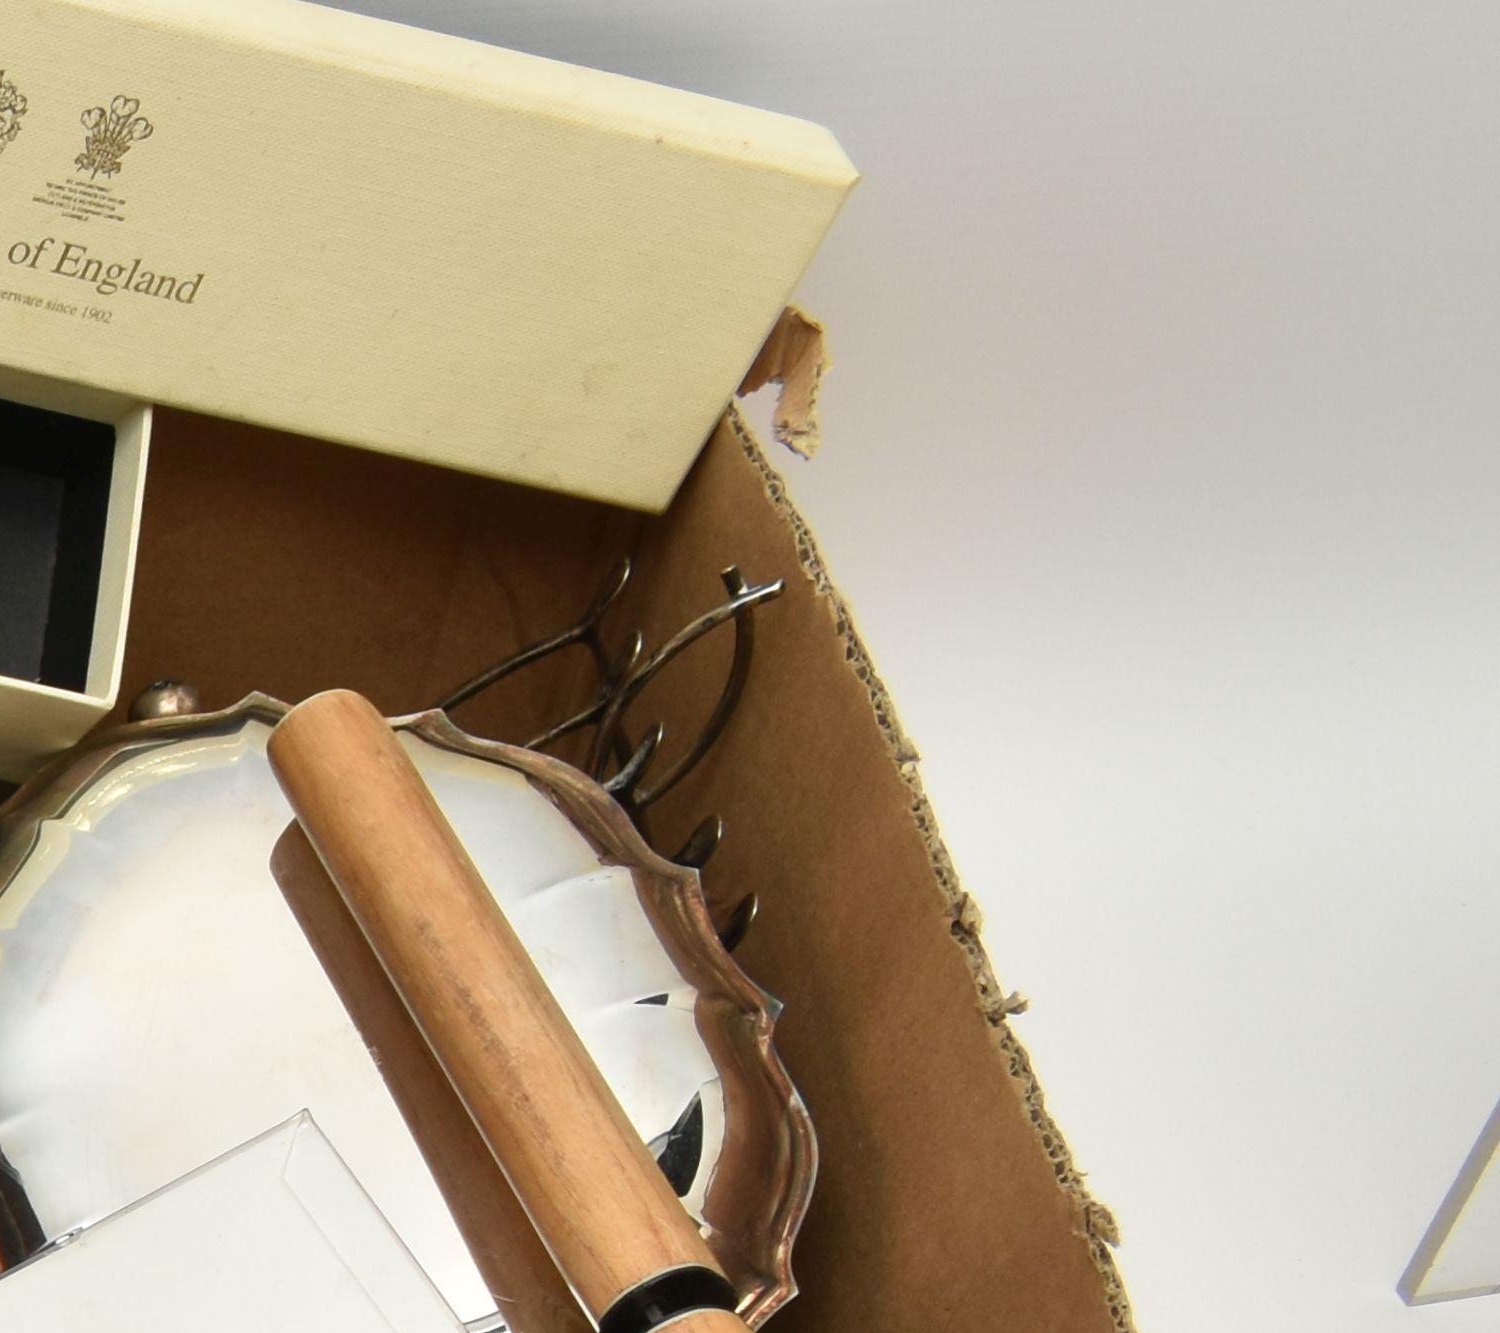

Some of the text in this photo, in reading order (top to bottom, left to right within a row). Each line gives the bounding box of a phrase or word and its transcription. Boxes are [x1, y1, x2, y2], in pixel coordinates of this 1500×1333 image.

[8, 236, 55, 269] of
[51, 241, 205, 305] England
[44, 298, 78, 316] since
[81, 305, 113, 324] 1902
